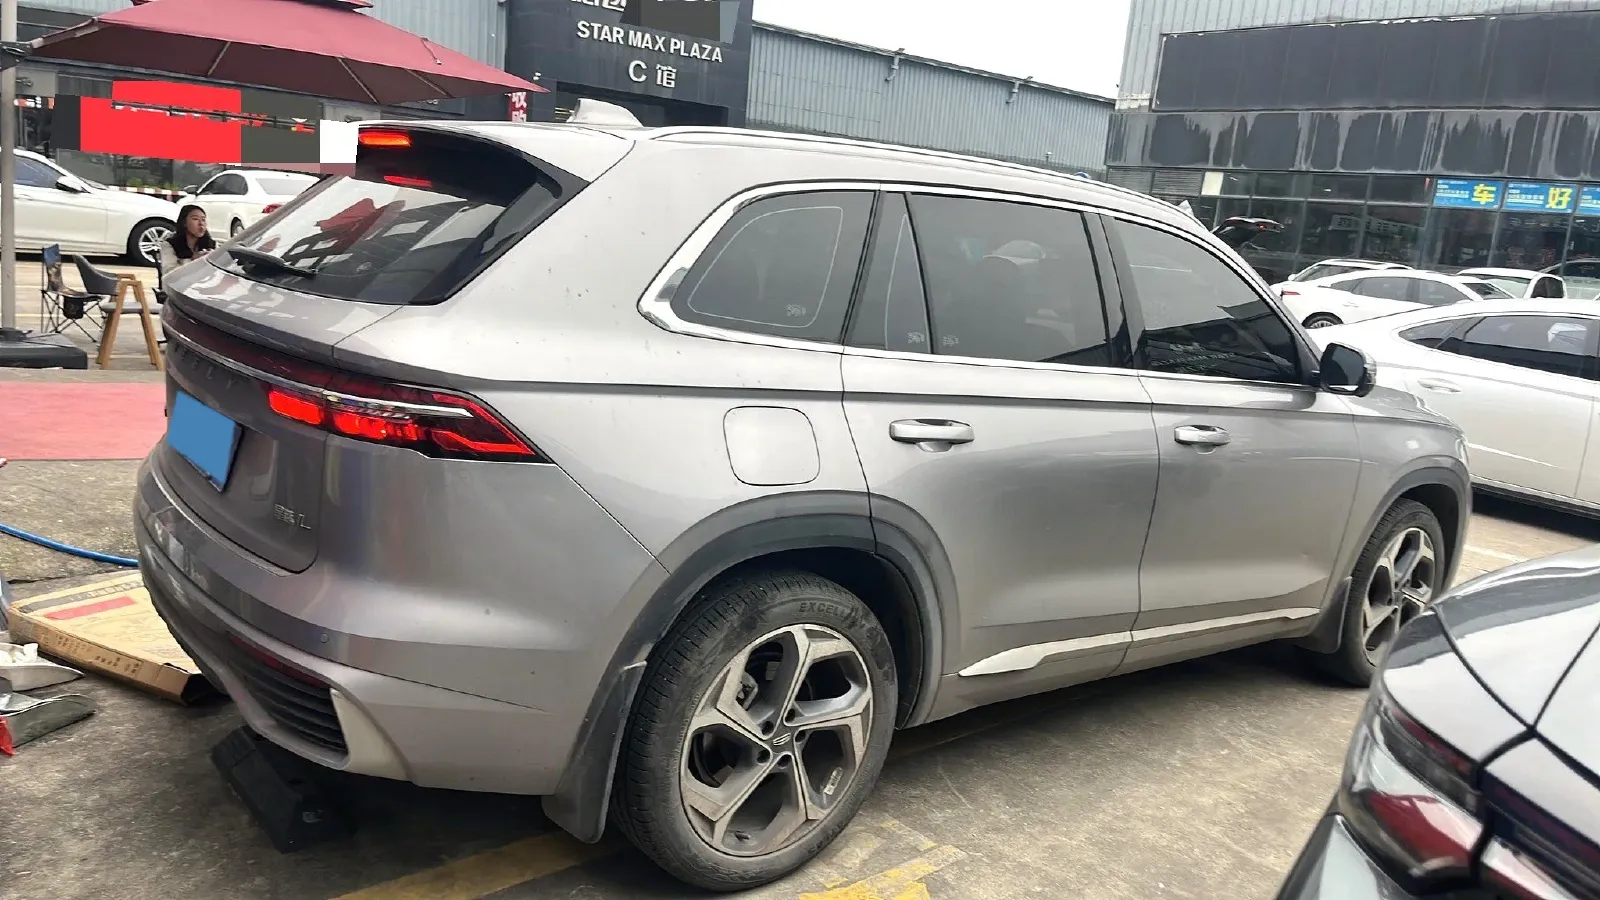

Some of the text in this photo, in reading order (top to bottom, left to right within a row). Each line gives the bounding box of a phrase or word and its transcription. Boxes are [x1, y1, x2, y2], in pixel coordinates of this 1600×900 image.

[576, 20, 724, 63] STAR MAX PLAZA
[628, 60, 677, 88] C 馆
[1471, 183, 1497, 205] 车
[1545, 187, 1573, 209] 好
